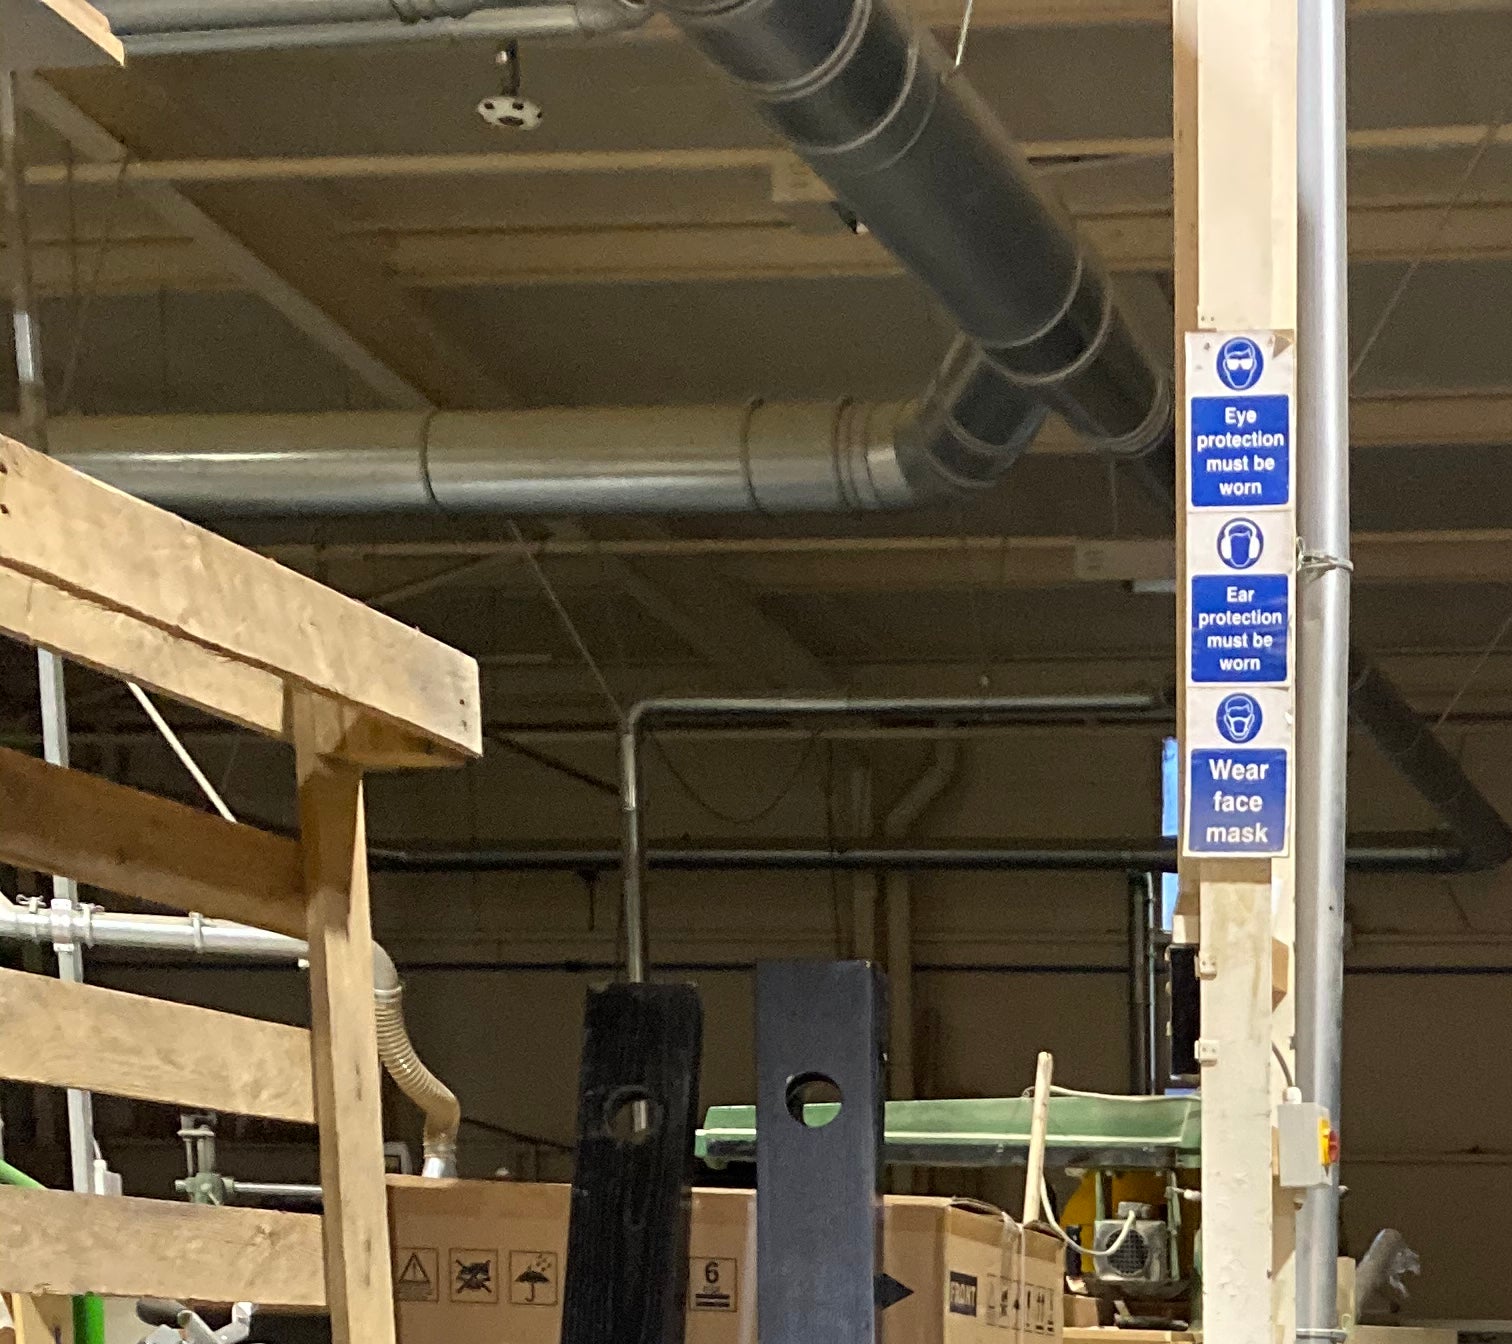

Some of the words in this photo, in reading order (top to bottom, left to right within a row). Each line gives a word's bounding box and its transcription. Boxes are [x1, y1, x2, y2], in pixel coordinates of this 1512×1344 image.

[1225, 407, 1257, 426] Eye
[1197, 431, 1285, 452] protection
[1206, 456, 1249, 472] must
[1253, 454, 1275, 472] be
[1219, 481, 1262, 496] worn
[1226, 586, 1255, 603] Ear
[1198, 609, 1283, 629] protection
[1207, 634, 1249, 648] must
[1252, 632, 1274, 648] be
[1219, 657, 1261, 671] worn
[1208, 758, 1270, 781] Wear
[1213, 791, 1264, 813] face
[1206, 822, 1269, 843] mask
[705, 1261, 719, 1283] 6
